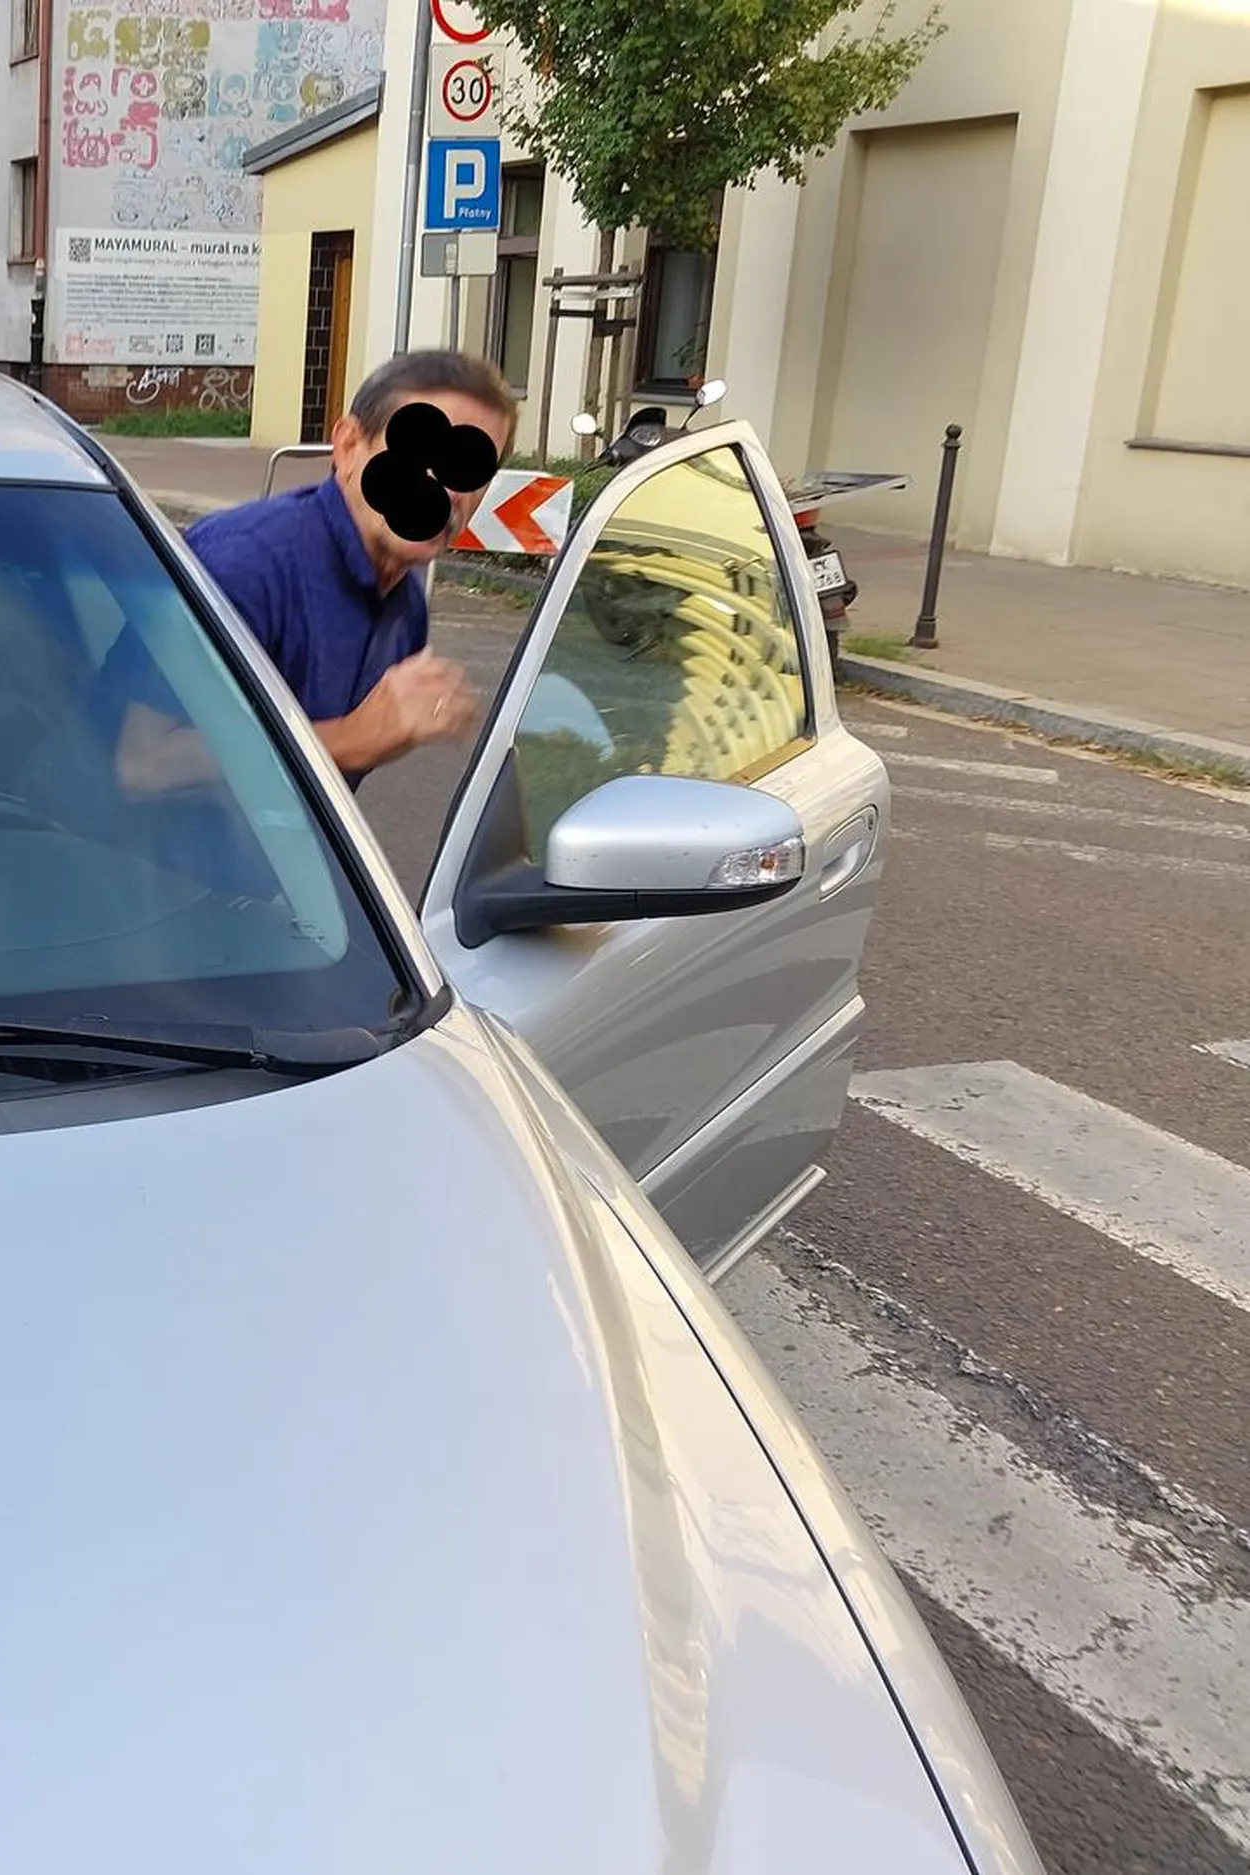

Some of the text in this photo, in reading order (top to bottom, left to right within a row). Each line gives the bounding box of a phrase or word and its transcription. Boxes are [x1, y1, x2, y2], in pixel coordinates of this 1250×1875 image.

[451, 76, 484, 105] 30
[443, 149, 485, 219] P
[94, 237, 178, 253] MAYAMURAL
[190, 241, 229, 254] mural
[233, 244, 249, 255] na
